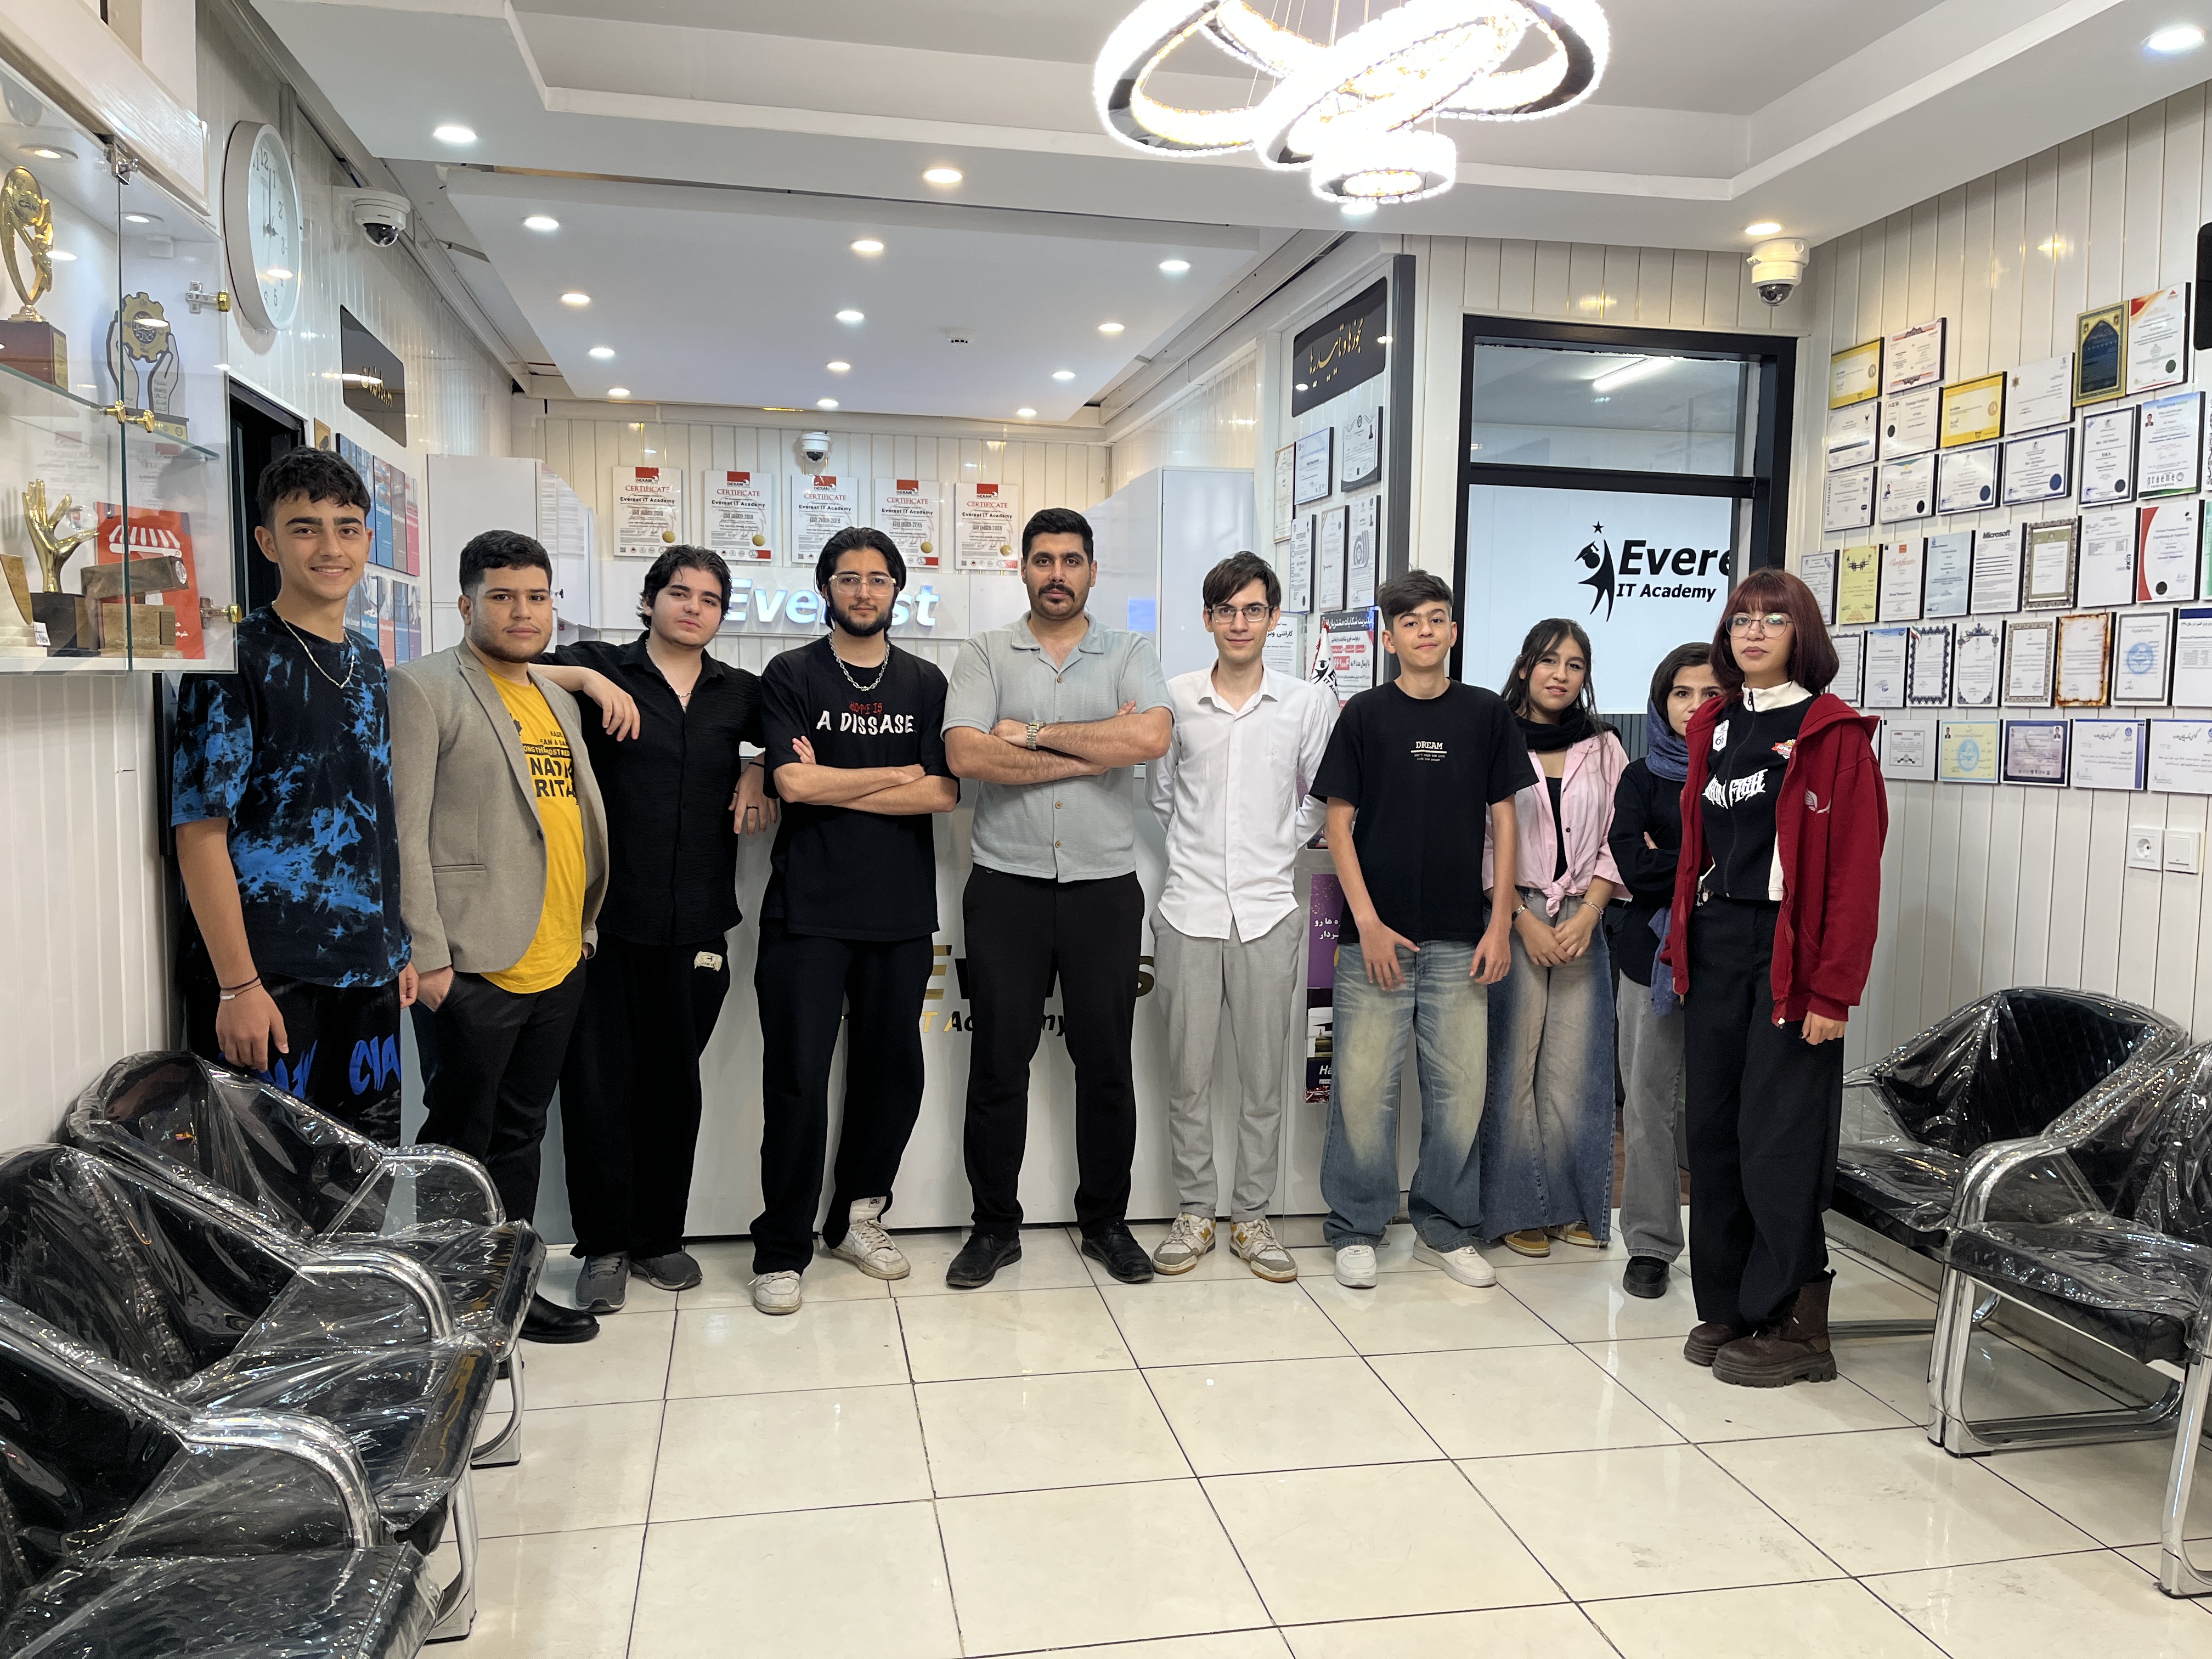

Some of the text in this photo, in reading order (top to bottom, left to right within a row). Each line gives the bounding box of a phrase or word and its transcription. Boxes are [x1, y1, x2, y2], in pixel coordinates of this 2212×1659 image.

[1982, 529, 2012, 539] Microsoft
[1616, 583, 1717, 602] IT Academy
[724, 578, 940, 627] Evest
[816, 710, 914, 735] A DISSASE
[1415, 741, 1443, 750] DREAM
